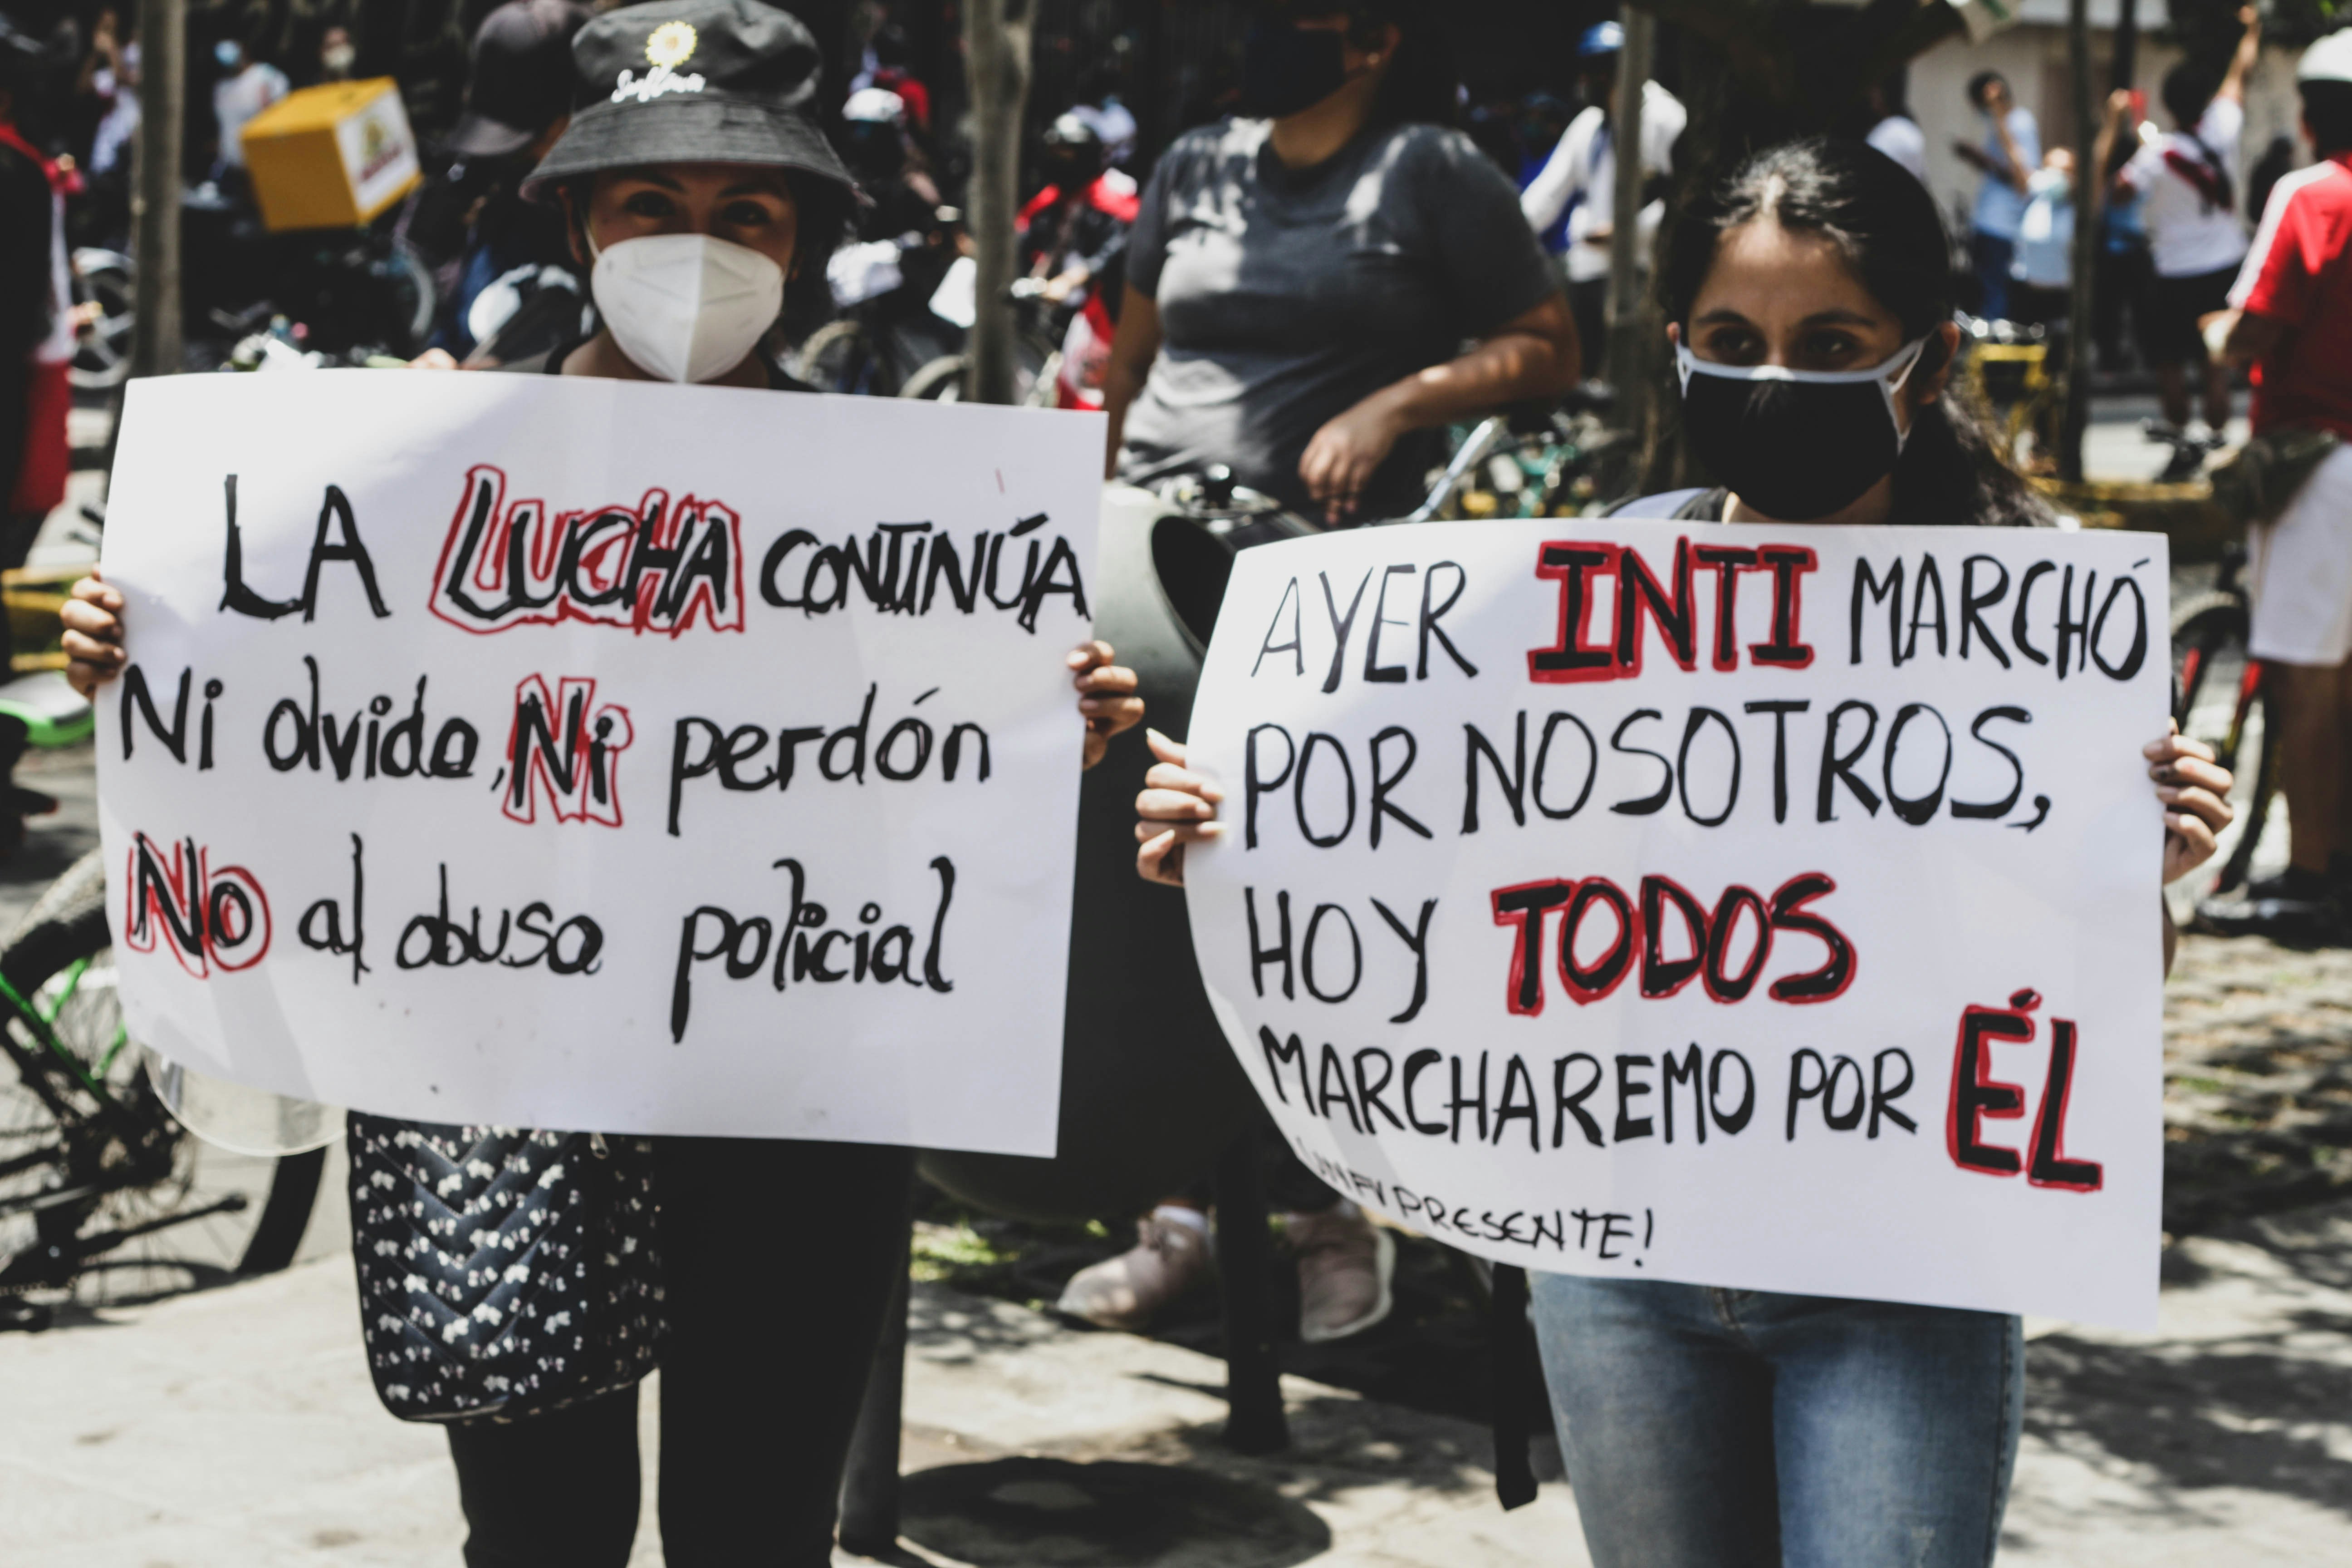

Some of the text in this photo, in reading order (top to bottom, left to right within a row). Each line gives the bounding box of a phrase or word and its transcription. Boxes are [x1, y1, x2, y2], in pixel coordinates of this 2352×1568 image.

[219, 475, 392, 623] LA
[429, 465, 744, 638] LUCHA
[1251, 536, 2149, 693] AYER INTI MARCHÓ
[120, 663, 224, 771] Ni
[502, 673, 634, 828] Ni
[667, 681, 990, 837] perdón
[1245, 700, 2051, 851] POR NOSOTROS,
[125, 832, 272, 979] No
[298, 833, 371, 985] al
[670, 856, 956, 1044] policial
[1244, 872, 1857, 1024] HOY TODOS
[1259, 988, 2103, 1194] MARCHAREMO POR ÉL
[1393, 1184, 1654, 1267] PRESENTE!
